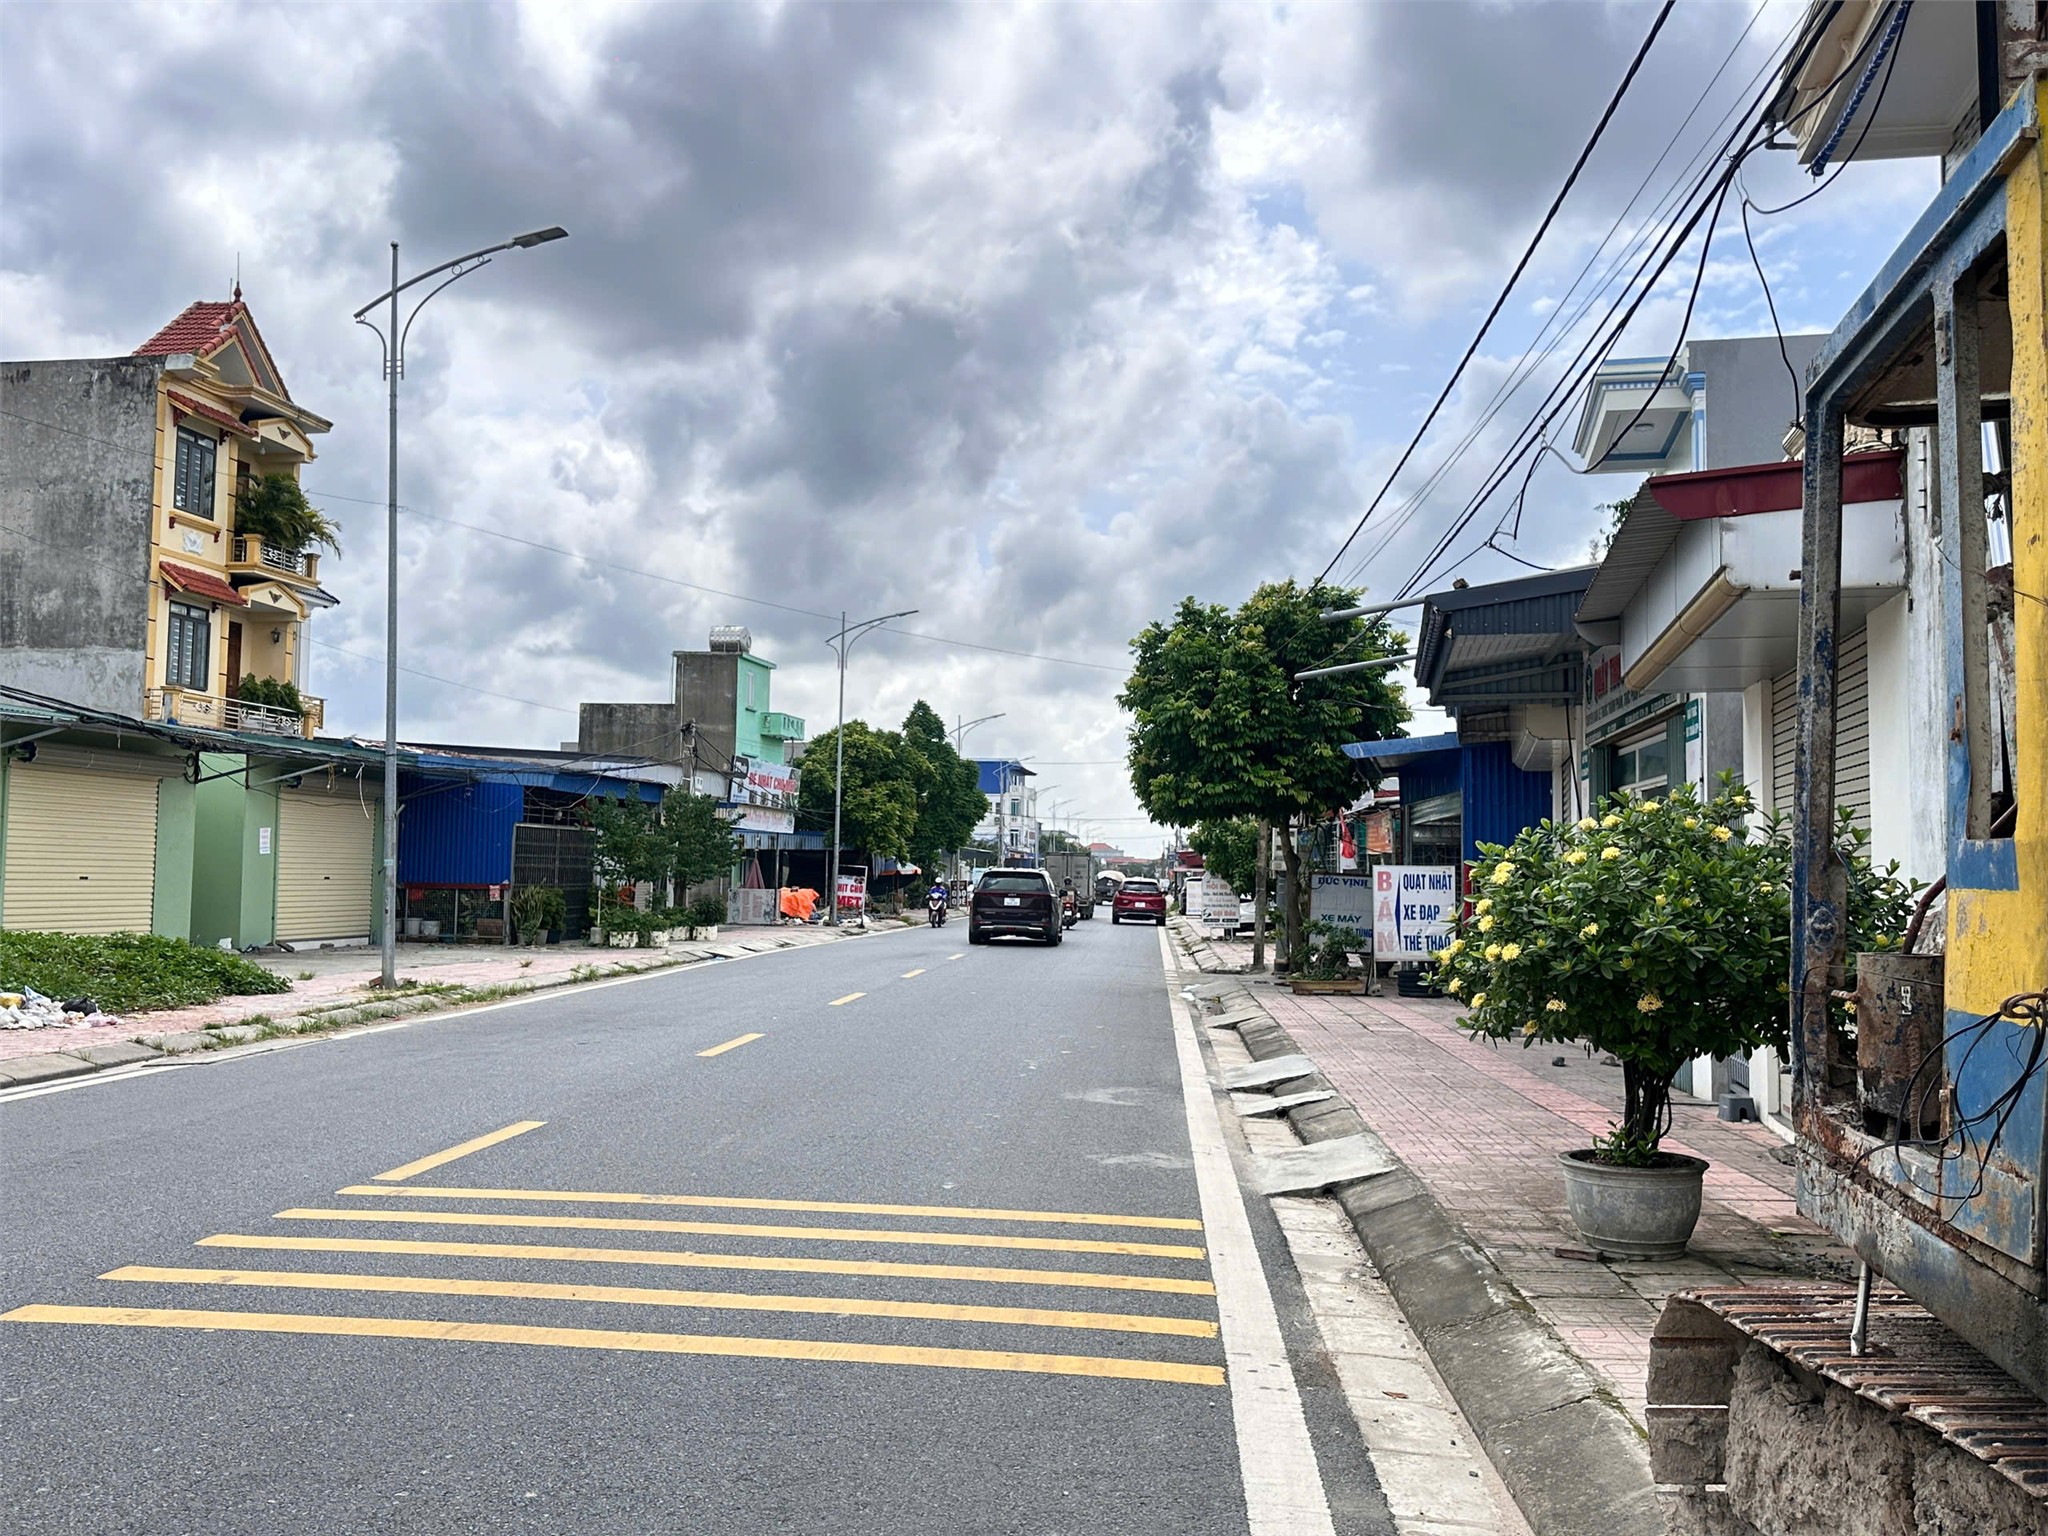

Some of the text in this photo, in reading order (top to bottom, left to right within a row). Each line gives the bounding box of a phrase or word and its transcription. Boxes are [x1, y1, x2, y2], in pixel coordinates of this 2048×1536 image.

[1342, 878, 1368, 888] VỊNH
[1403, 871, 1453, 894] QUẠT NHẬT
[1321, 913, 1362, 923] XE MÁY
[1403, 904, 1440, 924] XE ĐẠP
[1404, 929, 1451, 951] THỂ THAO
